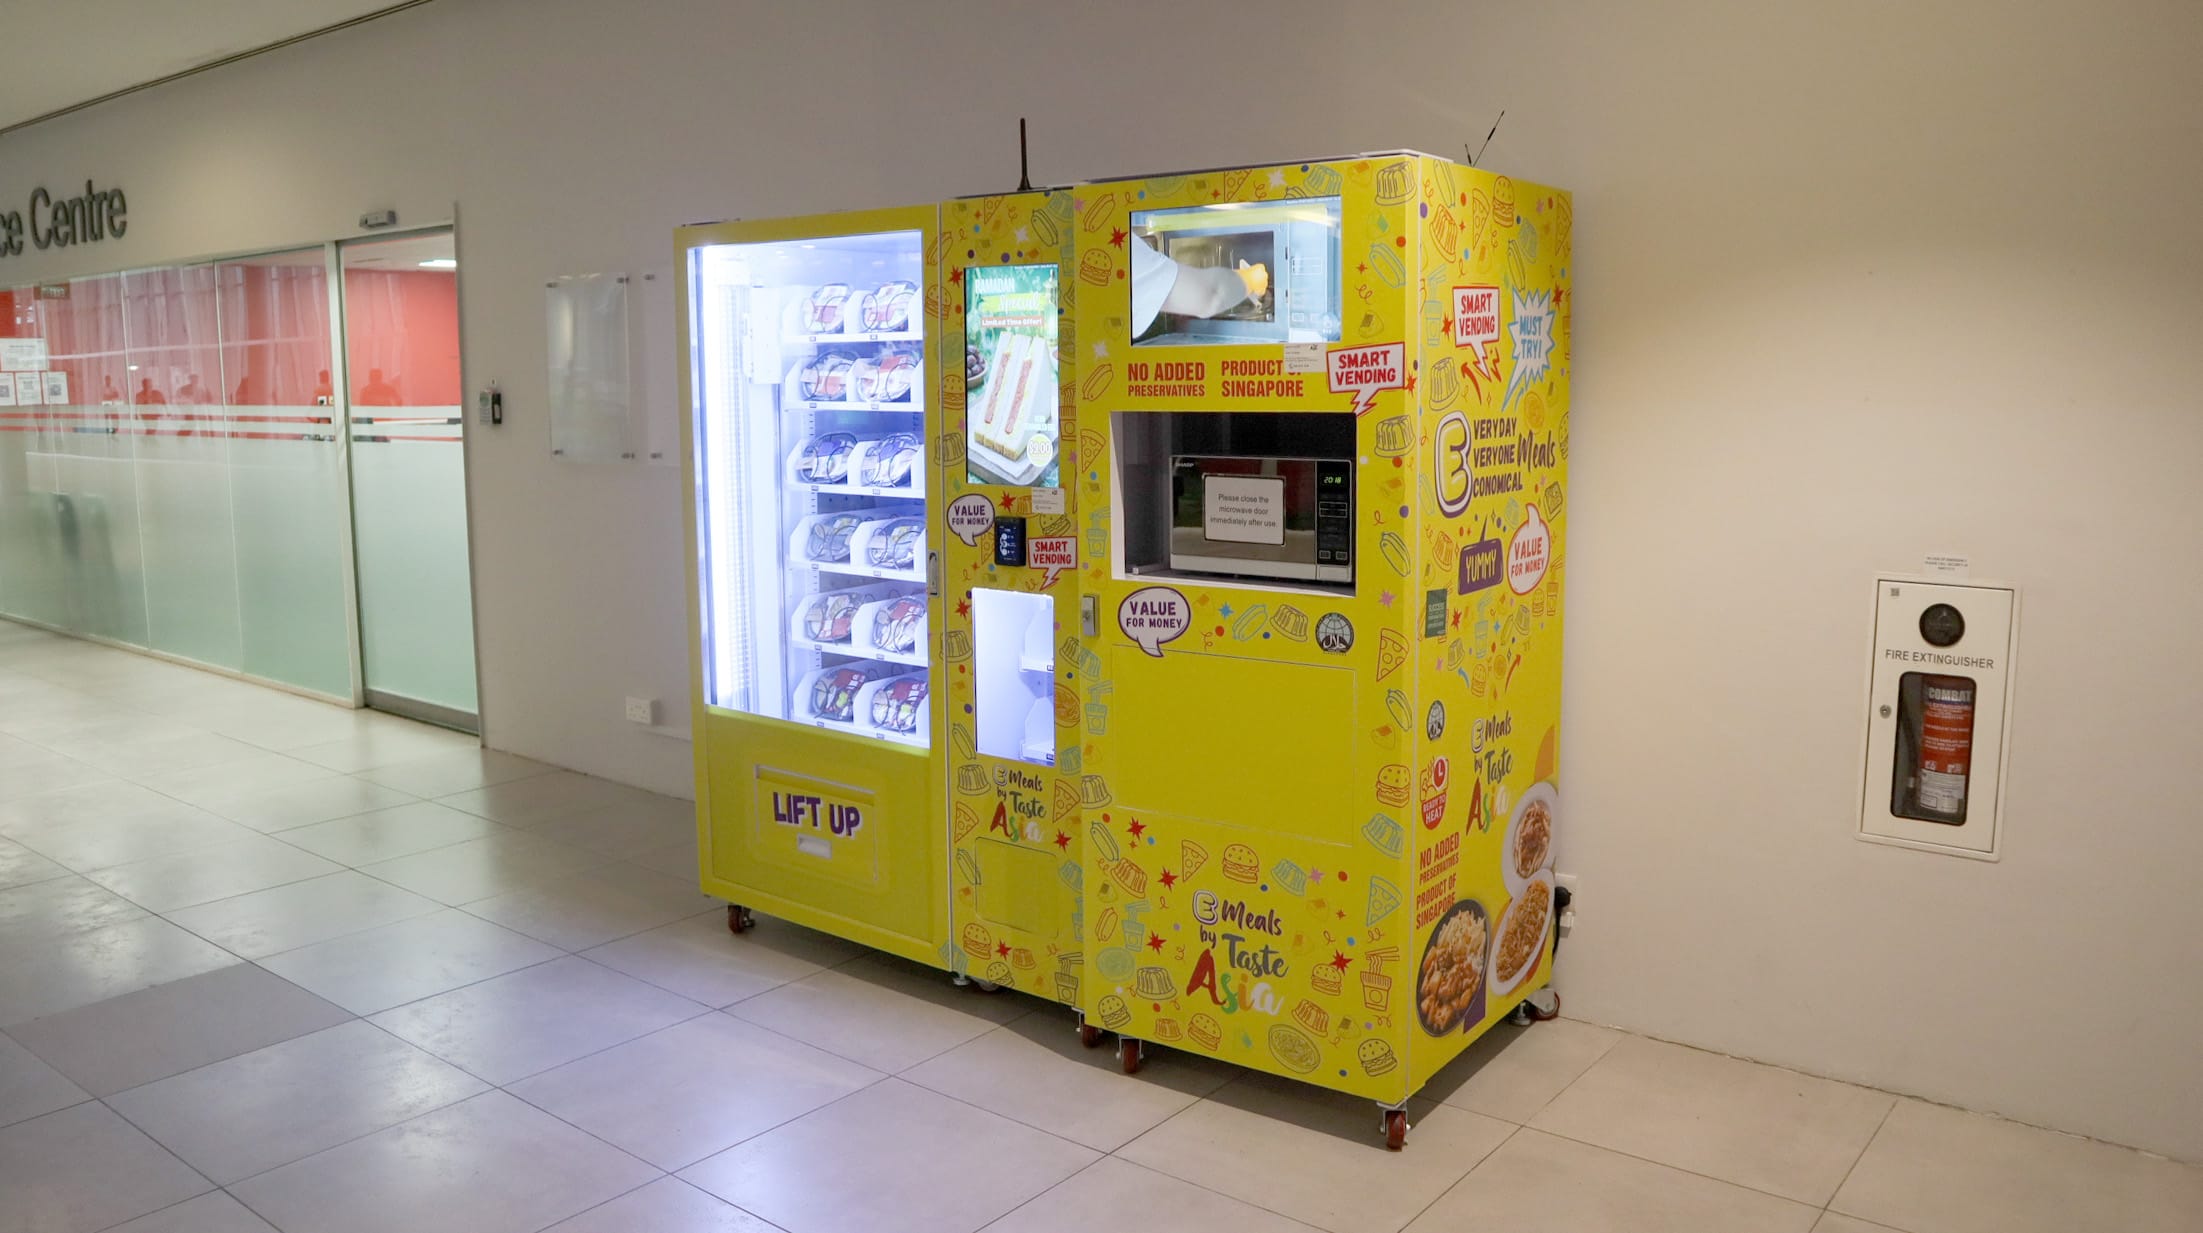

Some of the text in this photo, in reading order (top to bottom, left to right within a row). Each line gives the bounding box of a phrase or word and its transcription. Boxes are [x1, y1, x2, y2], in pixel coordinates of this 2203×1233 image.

[29, 179, 127, 250] Centre
[1461, 293, 1492, 314] SMART
[1459, 315, 1495, 337] VENDING
[1520, 315, 1543, 336] MUST
[1521, 338, 1542, 359] TRY!
[1221, 360, 1283, 377] PRODUCT
[1338, 350, 1391, 369] SMART
[1128, 362, 1205, 381] NO ADDED
[1335, 366, 1396, 386] VENDING
[1128, 384, 1205, 397] PRESERVATIVES
[1221, 380, 1304, 397] SINGAPORE
[1517, 430, 1556, 472] Meals
[1218, 493, 1239, 502] Please
[1240, 495, 1258, 503] close
[954, 504, 986, 516] VALUE
[1218, 505, 1269, 515] microwave door
[952, 517, 990, 526] FOR MONEY
[1210, 517, 1247, 527] immediately
[1248, 518, 1263, 527] after
[1035, 541, 1068, 552] SMART
[1514, 537, 1543, 560] VALUE
[1033, 553, 1072, 565] VENDING
[1465, 549, 1497, 584] YUMMY
[1511, 558, 1544, 576] FOR MONEY
[1130, 601, 1176, 616] VALUE
[1126, 618, 1182, 629] FOR MONEY
[1885, 649, 1995, 669] FIRE EXTINGUISHER
[1928, 687, 1972, 702] COMBAT
[1485, 711, 1512, 742] Meals
[1474, 746, 1514, 785] by Taste
[1009, 769, 1043, 792] Meals
[997, 786, 1047, 819] by Taste
[1466, 776, 1509, 836] Asia
[772, 791, 861, 838] LIFT UP
[990, 800, 1045, 843] Asia
[1425, 805, 1443, 825] HEAT
[1420, 832, 1460, 870] NO ADDED
[1417, 872, 1457, 910] PRODUCT OF
[1221, 900, 1283, 936] Meals
[1416, 891, 1456, 930] SINGAPORE
[1200, 925, 1289, 979] by Taste
[1186, 948, 1286, 1016] Asia
